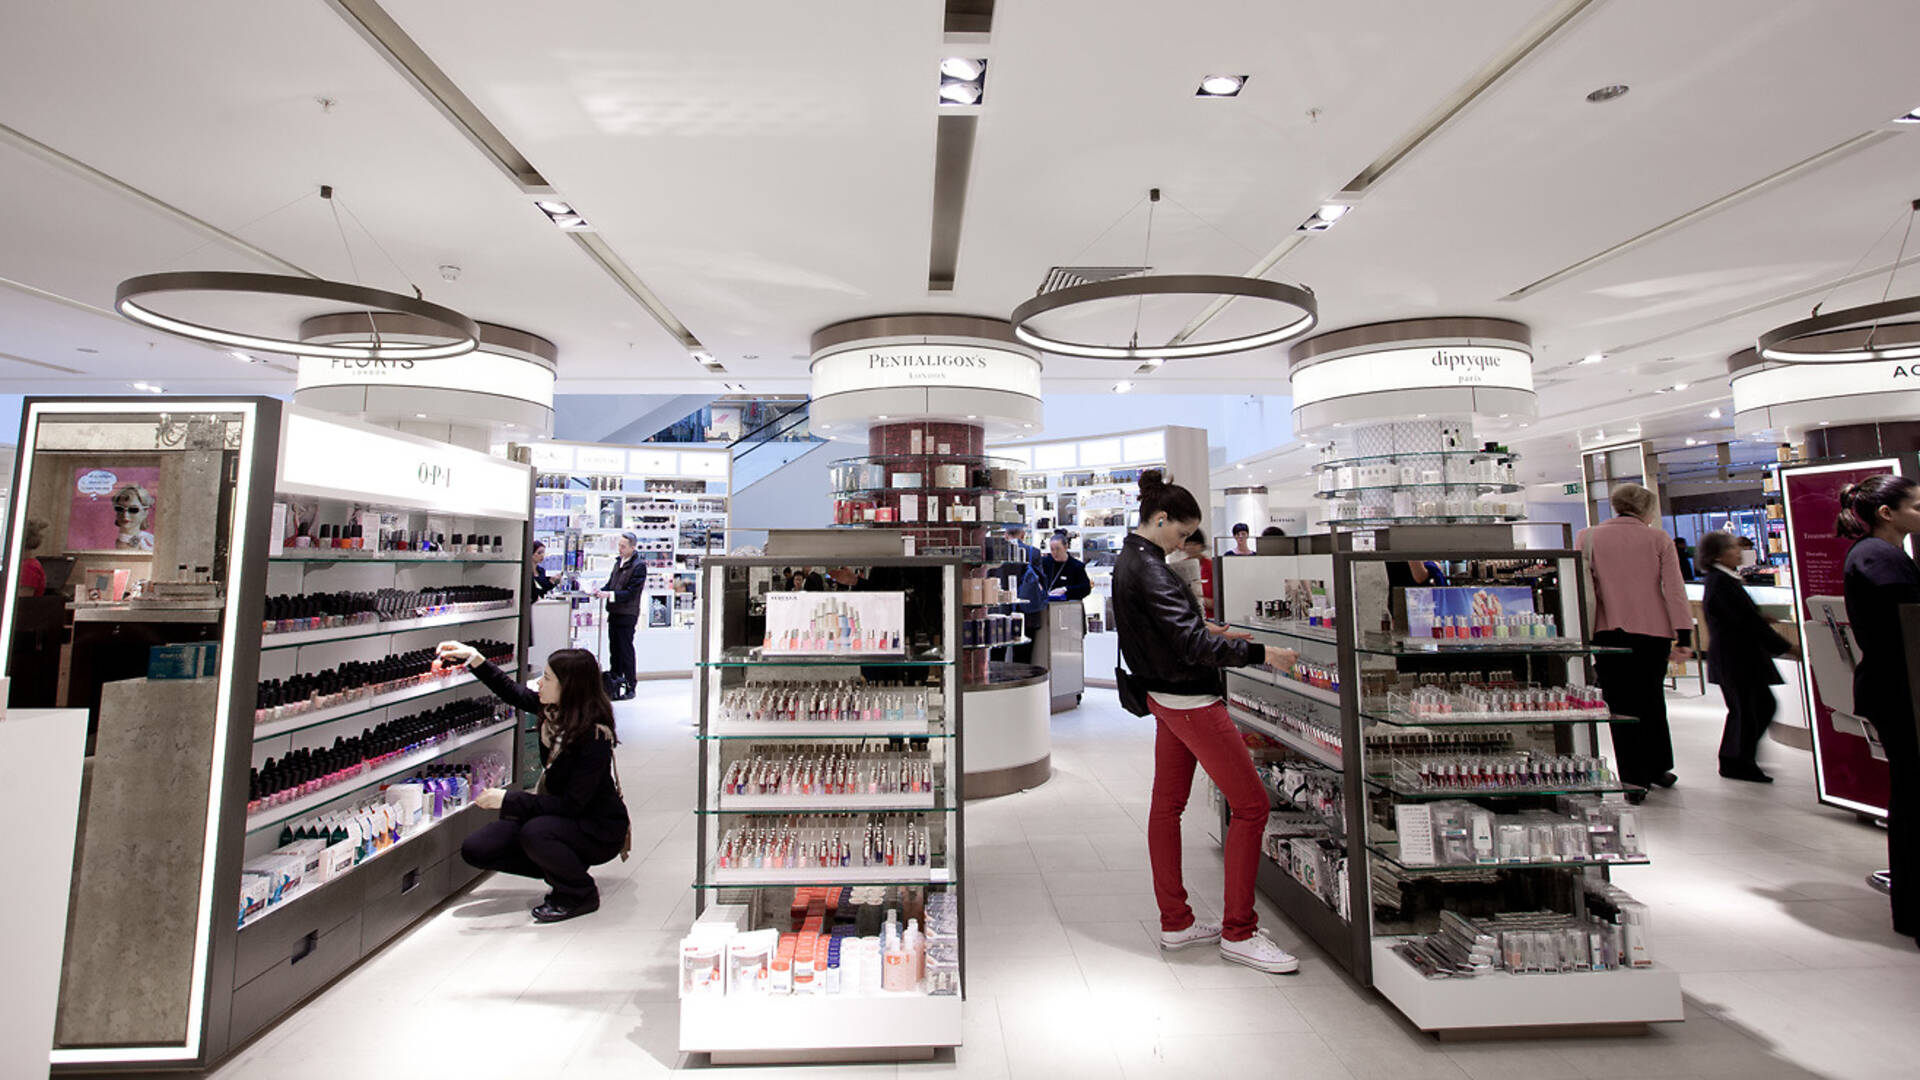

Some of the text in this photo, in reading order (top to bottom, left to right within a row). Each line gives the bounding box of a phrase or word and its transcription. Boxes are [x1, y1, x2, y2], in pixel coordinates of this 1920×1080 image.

[869, 354, 988, 369] PENHALIGON'S
[1432, 350, 1502, 371] diptyque
[1458, 375, 1482, 384] paris
